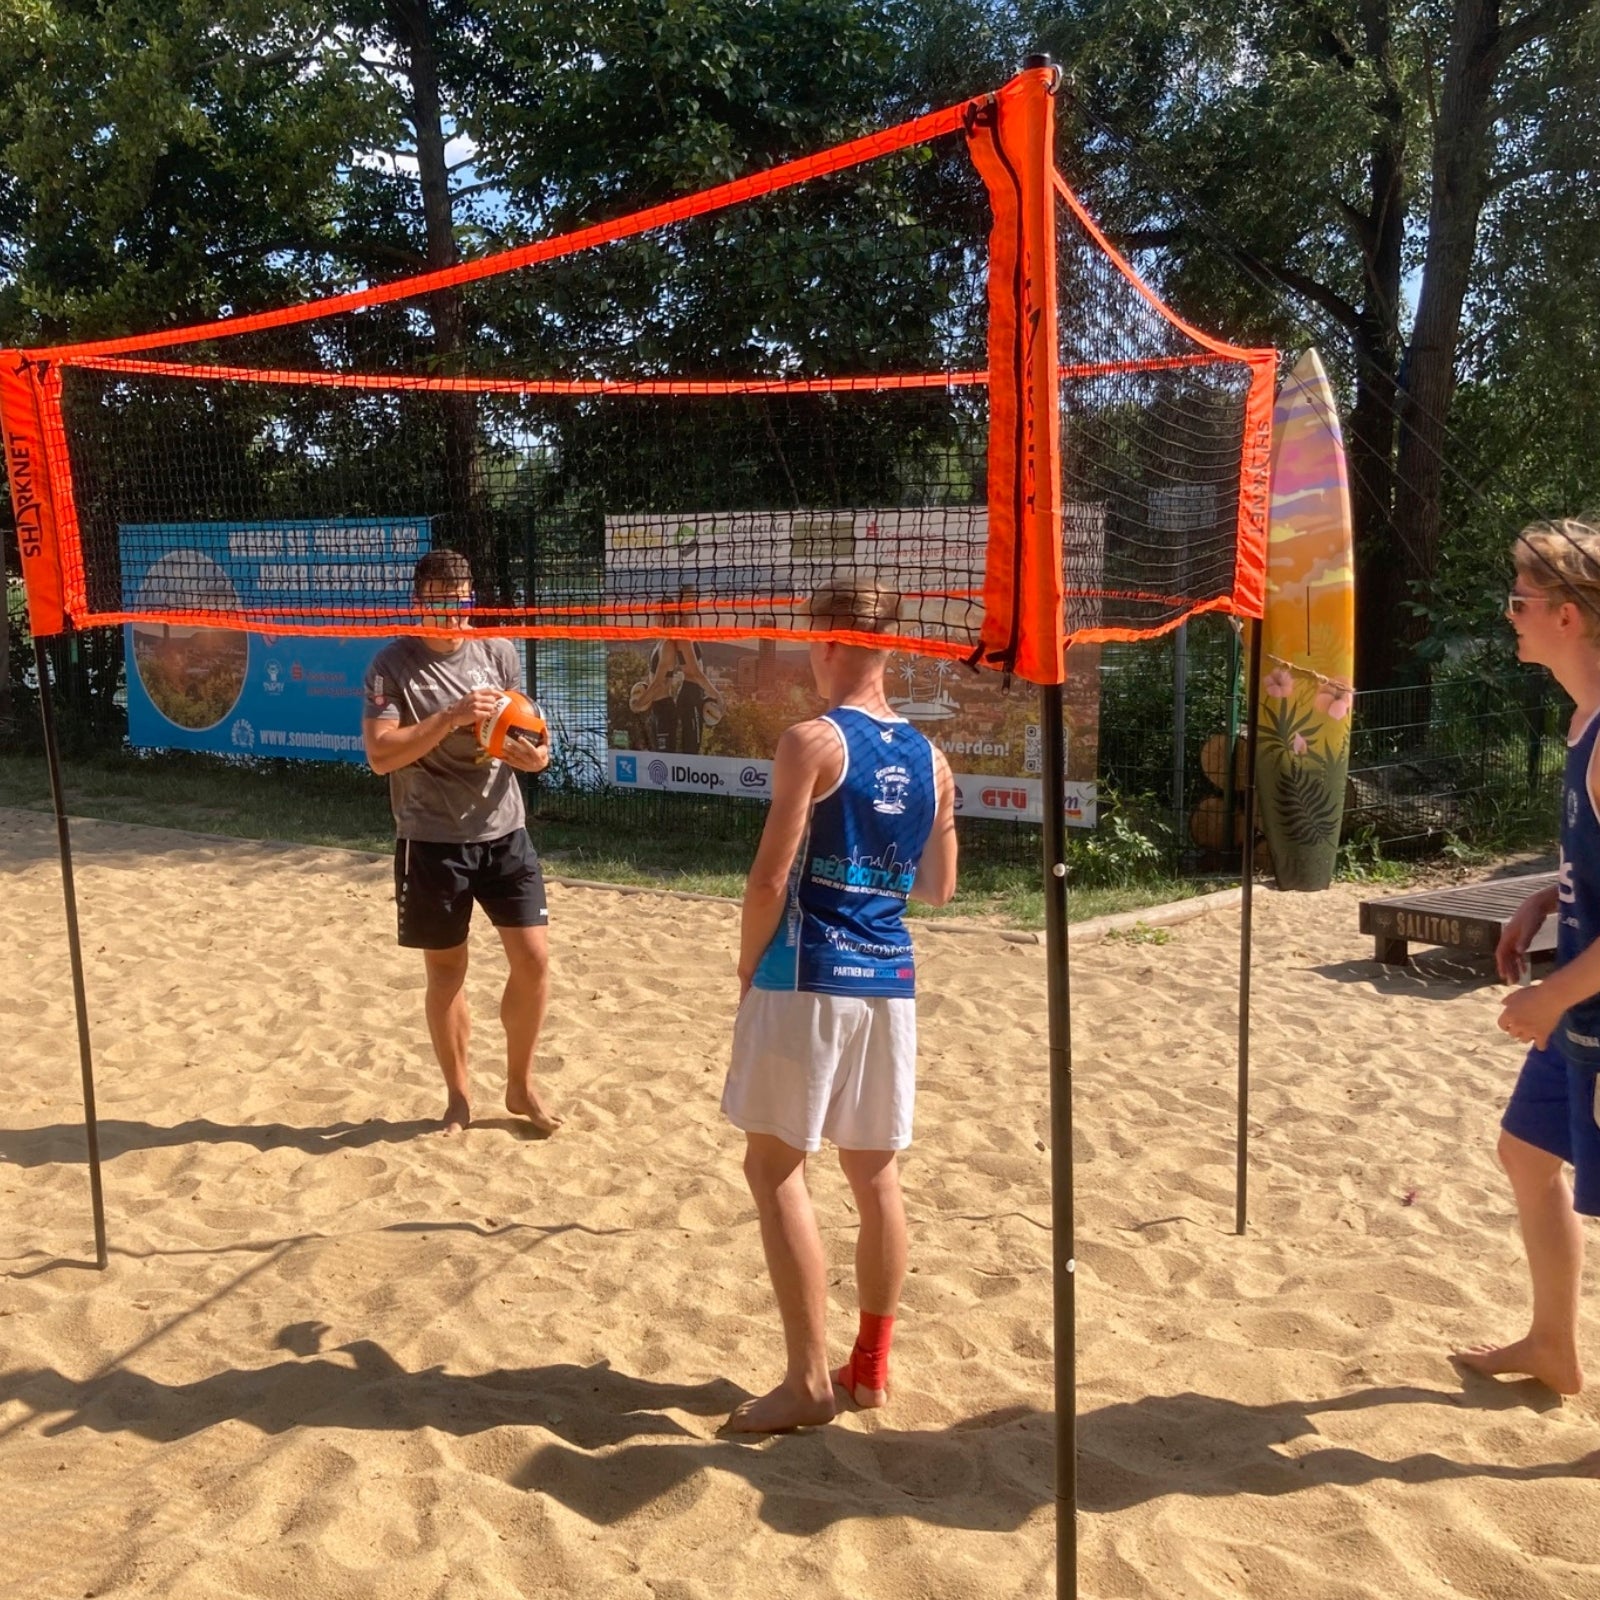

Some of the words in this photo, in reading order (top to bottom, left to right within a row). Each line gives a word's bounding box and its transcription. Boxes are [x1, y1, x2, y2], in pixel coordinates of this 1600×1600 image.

[941, 739, 1010, 757] werden!
[981, 788, 1027, 810] GTÜ
[1396, 912, 1461, 945] SALITOS
